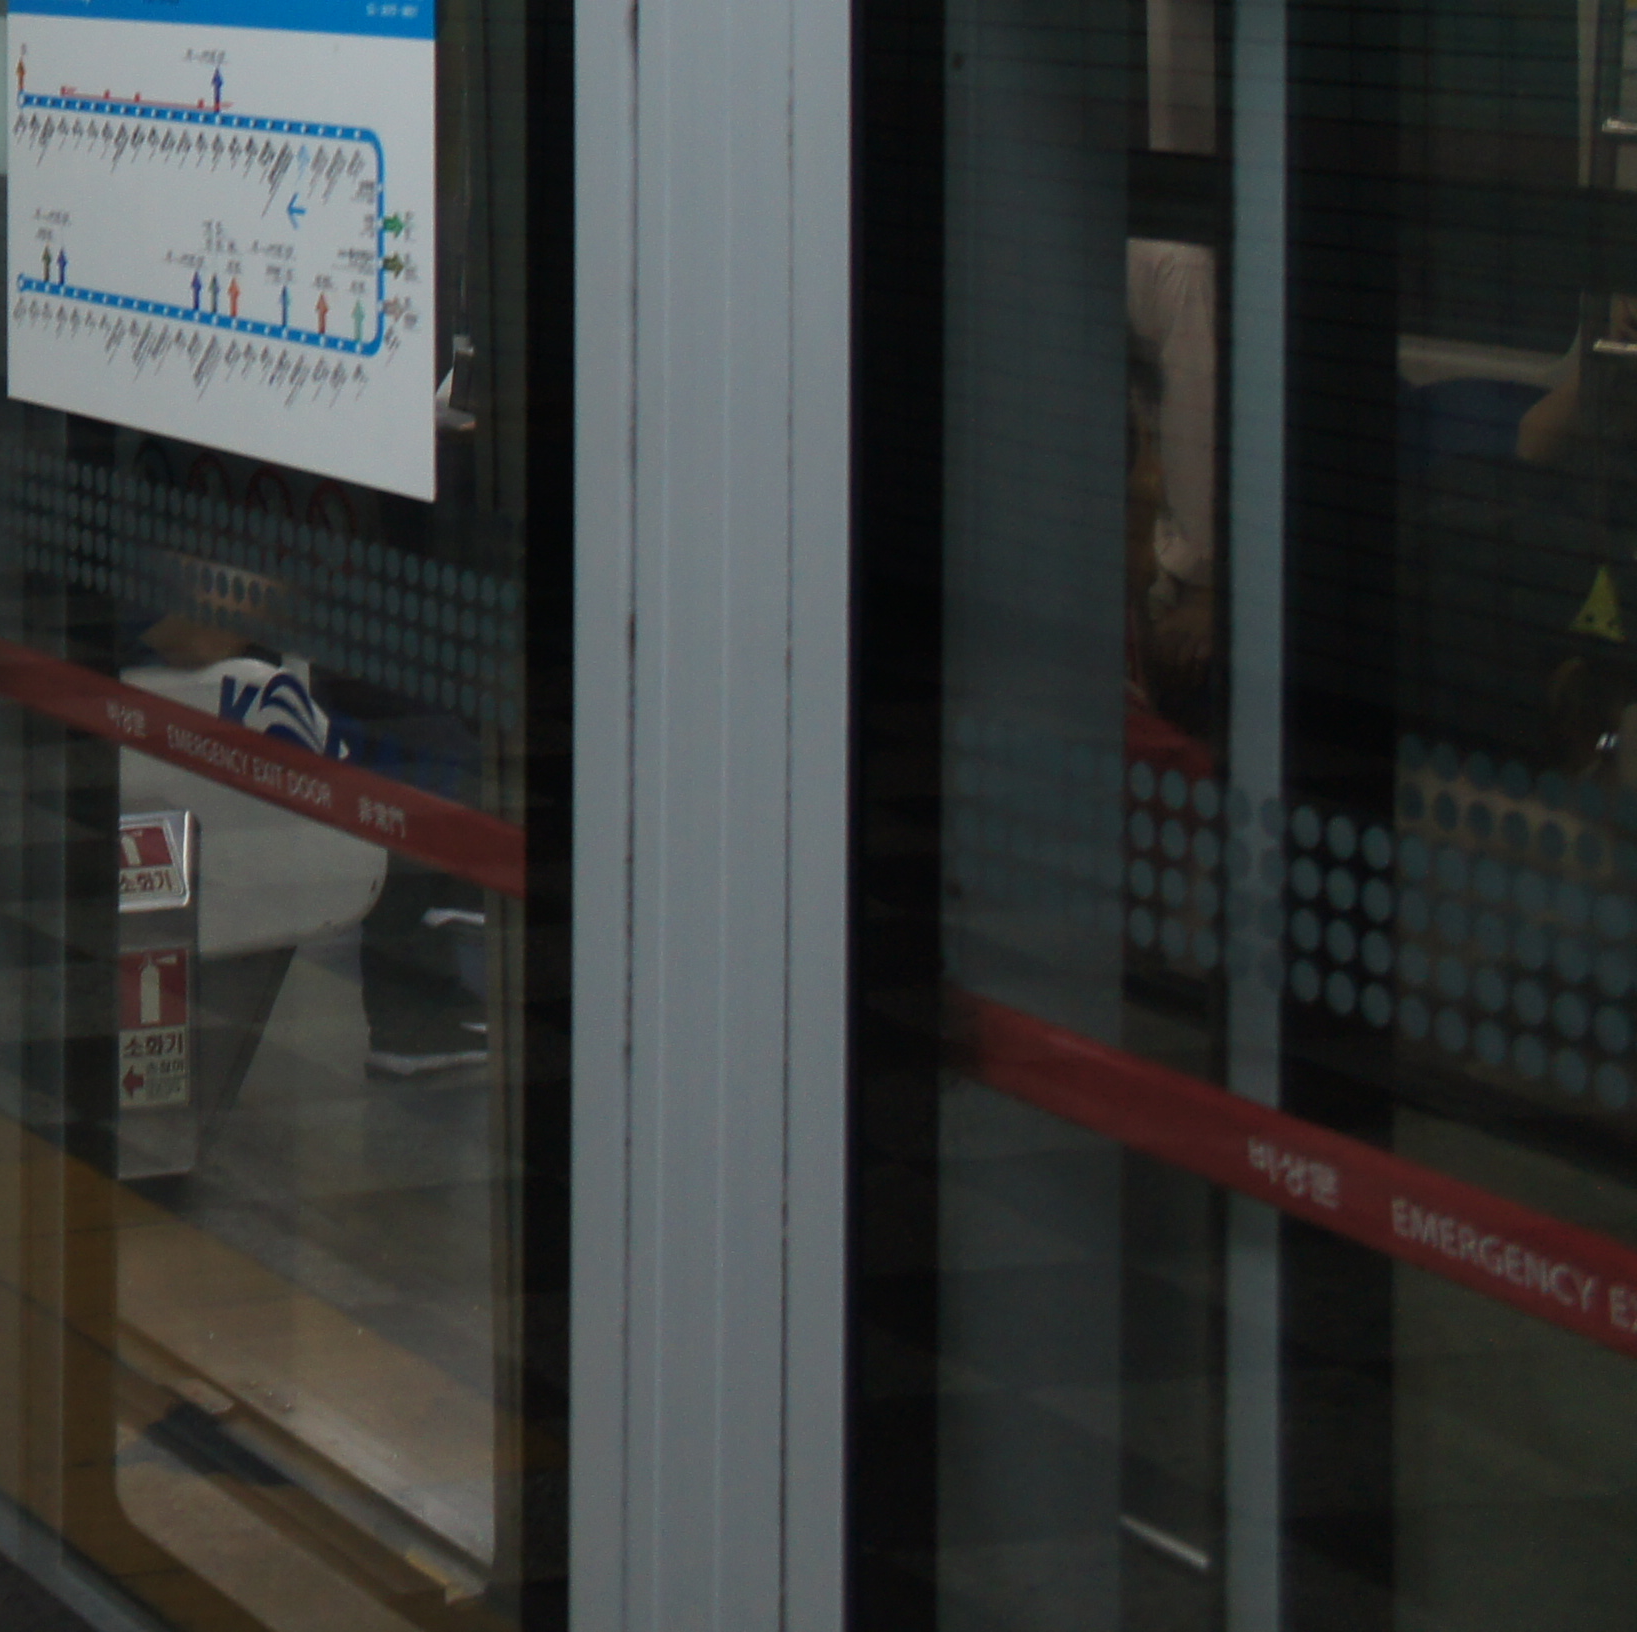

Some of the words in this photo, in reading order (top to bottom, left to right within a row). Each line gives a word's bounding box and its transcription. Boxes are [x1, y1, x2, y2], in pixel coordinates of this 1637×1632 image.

[166, 724, 248, 775] EMERGENCY
[252, 756, 283, 790] EXIT
[287, 768, 331, 808] DOOR
[122, 1032, 184, 1058] 소화기
[1247, 1135, 1340, 1210] 비상문
[1391, 1195, 1599, 1313] EMERGENCY
